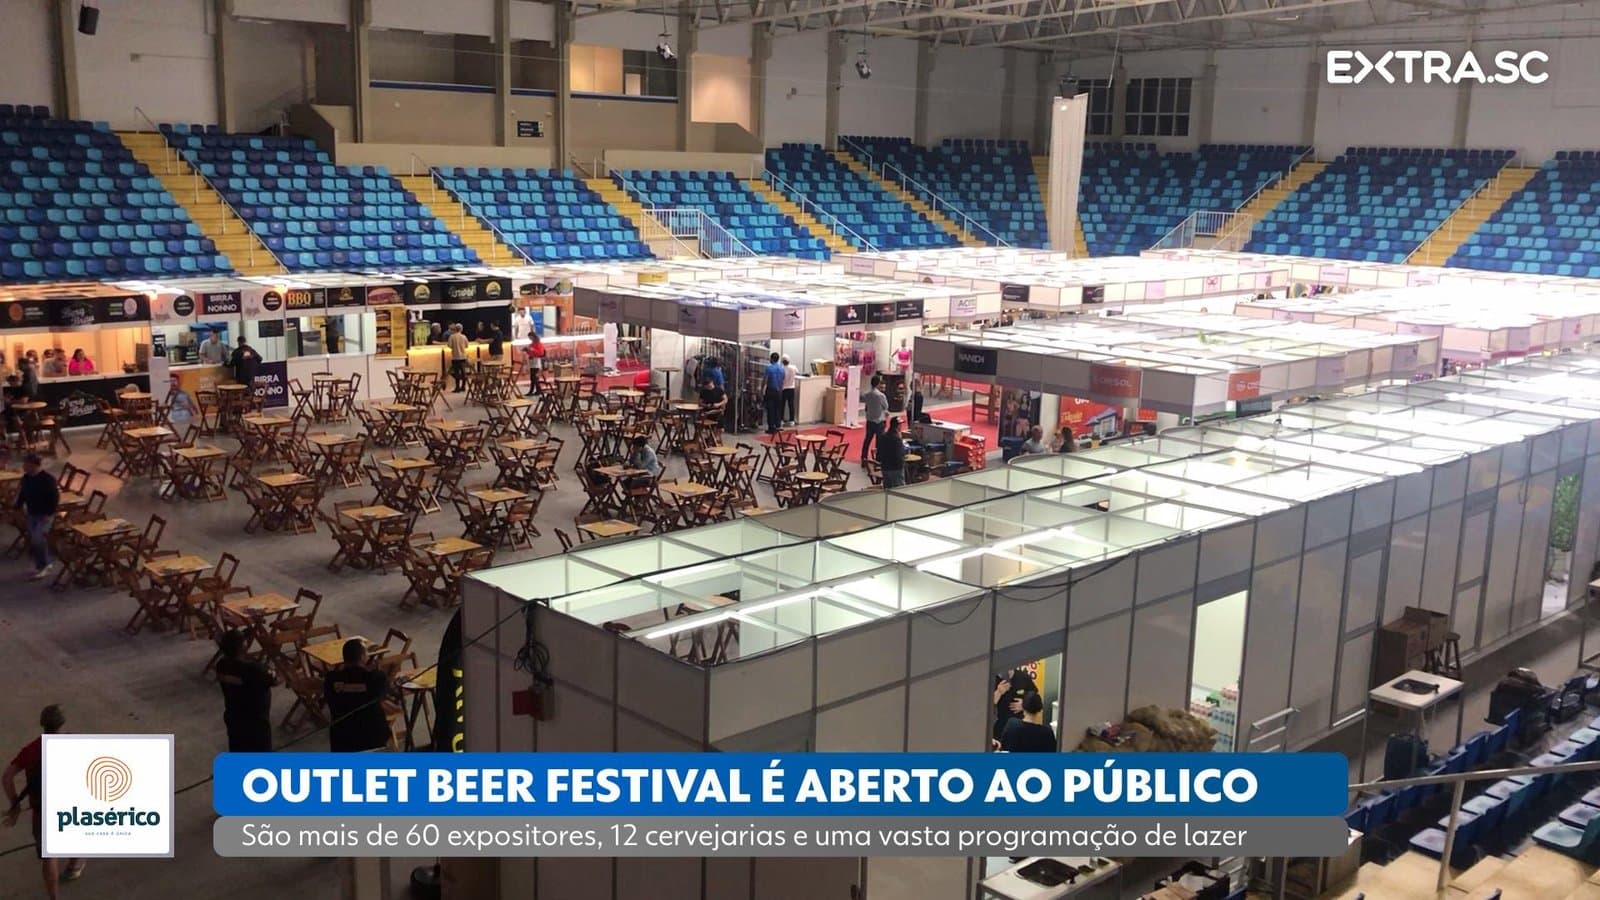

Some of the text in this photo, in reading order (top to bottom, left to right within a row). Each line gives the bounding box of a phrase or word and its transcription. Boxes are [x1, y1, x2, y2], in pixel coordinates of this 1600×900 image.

[210, 294, 233, 302] BIRRA
[288, 292, 311, 305] BBQ
[207, 304, 237, 312] NONNO
[254, 374, 280, 383] BIRRA
